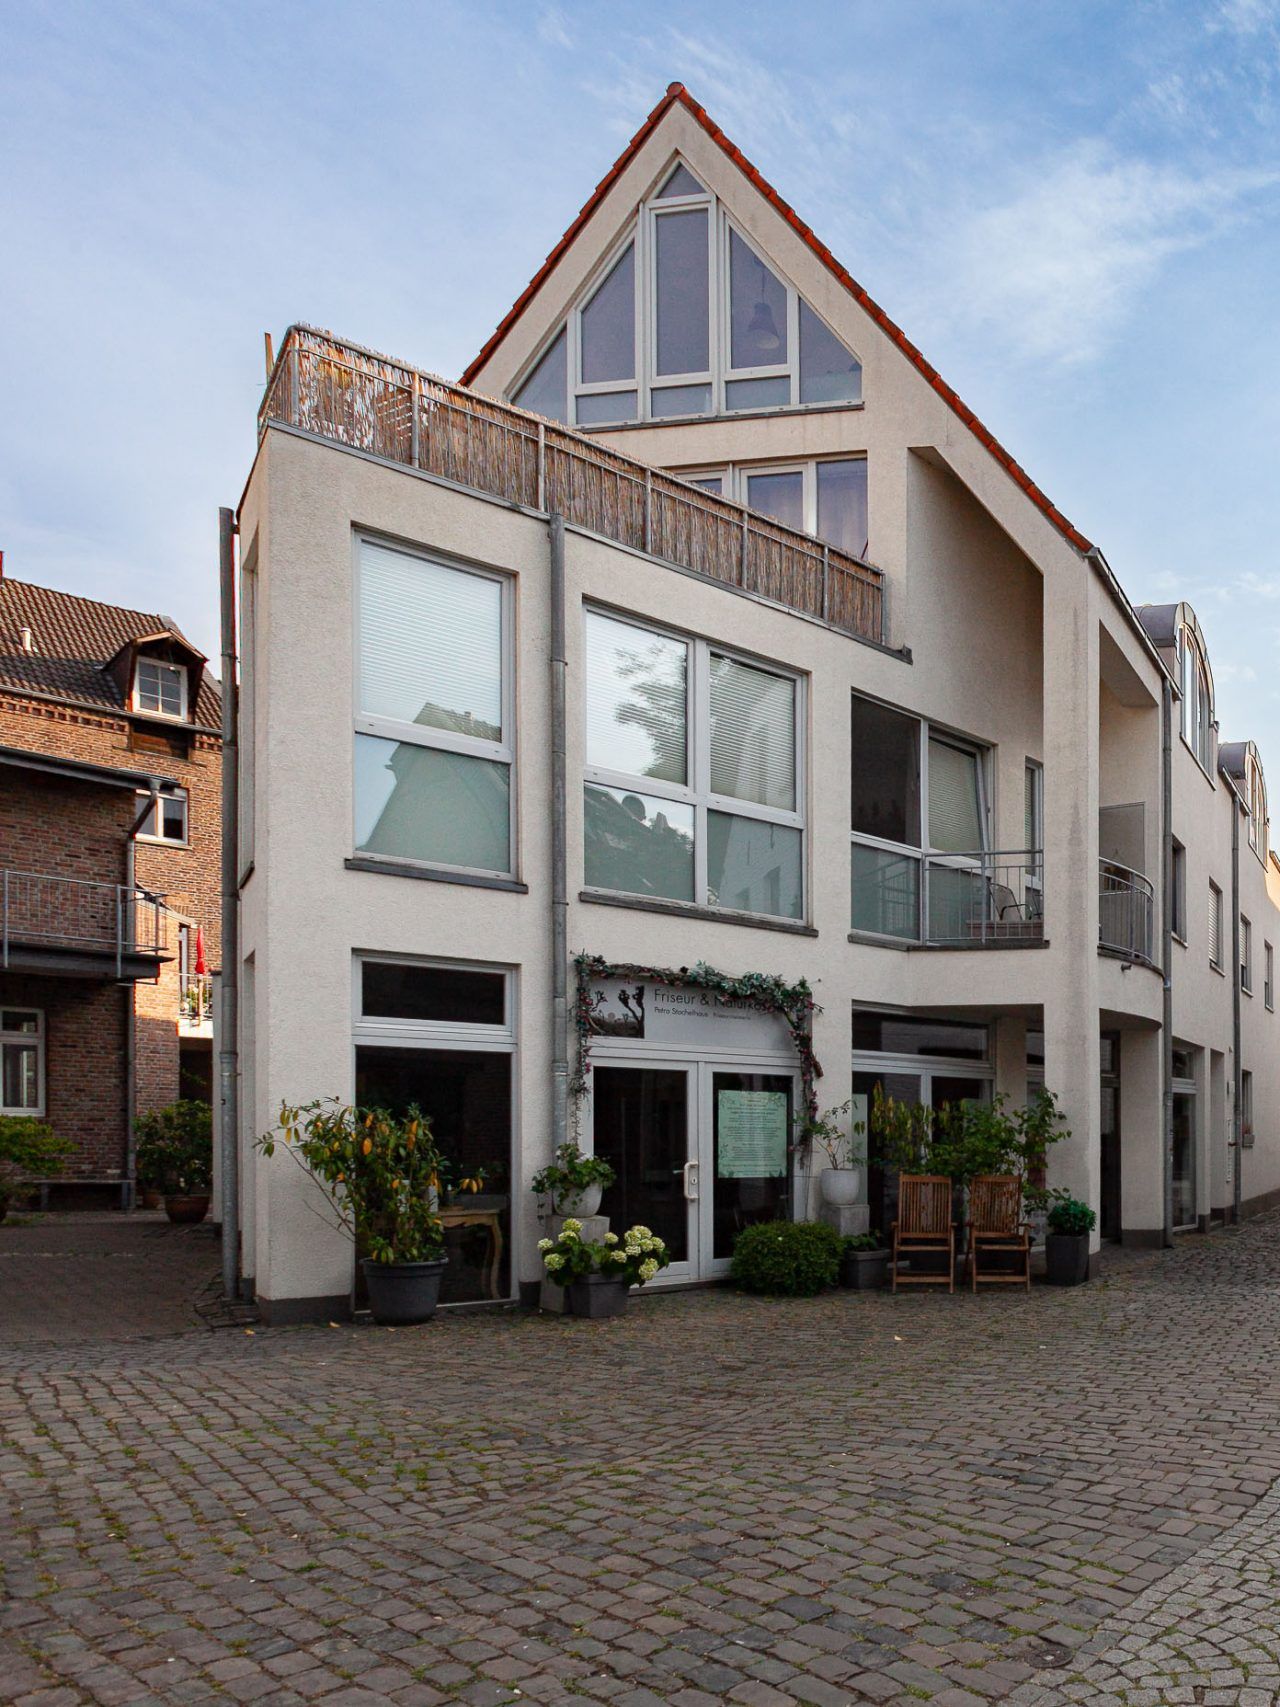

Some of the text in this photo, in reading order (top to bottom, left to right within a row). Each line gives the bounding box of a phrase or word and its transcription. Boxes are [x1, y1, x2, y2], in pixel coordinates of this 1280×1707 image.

[654, 988, 767, 1012] Friseur & Naturkos
